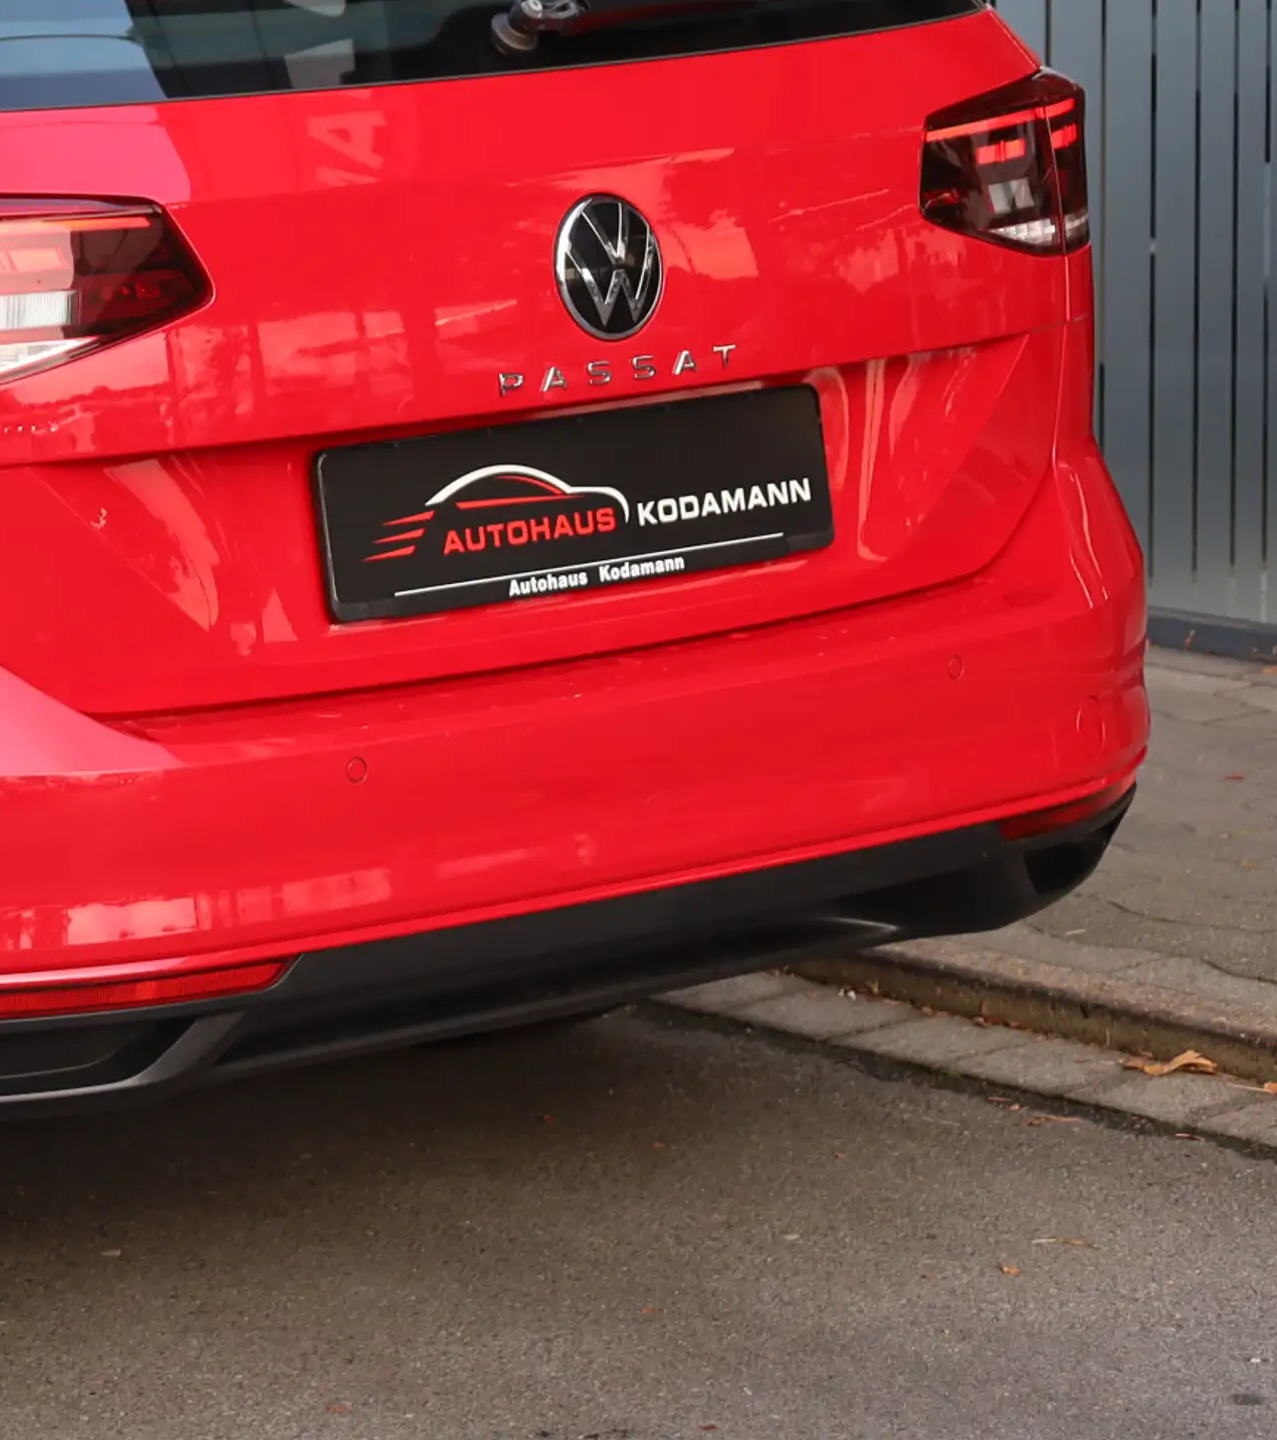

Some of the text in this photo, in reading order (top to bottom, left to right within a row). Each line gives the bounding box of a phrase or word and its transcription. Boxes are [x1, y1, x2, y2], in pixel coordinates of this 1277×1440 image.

[498, 344, 737, 398] PASSAT
[443, 477, 812, 555] AUTOHAUS KODAMANN
[508, 556, 685, 597] Autohaus Kodamann
